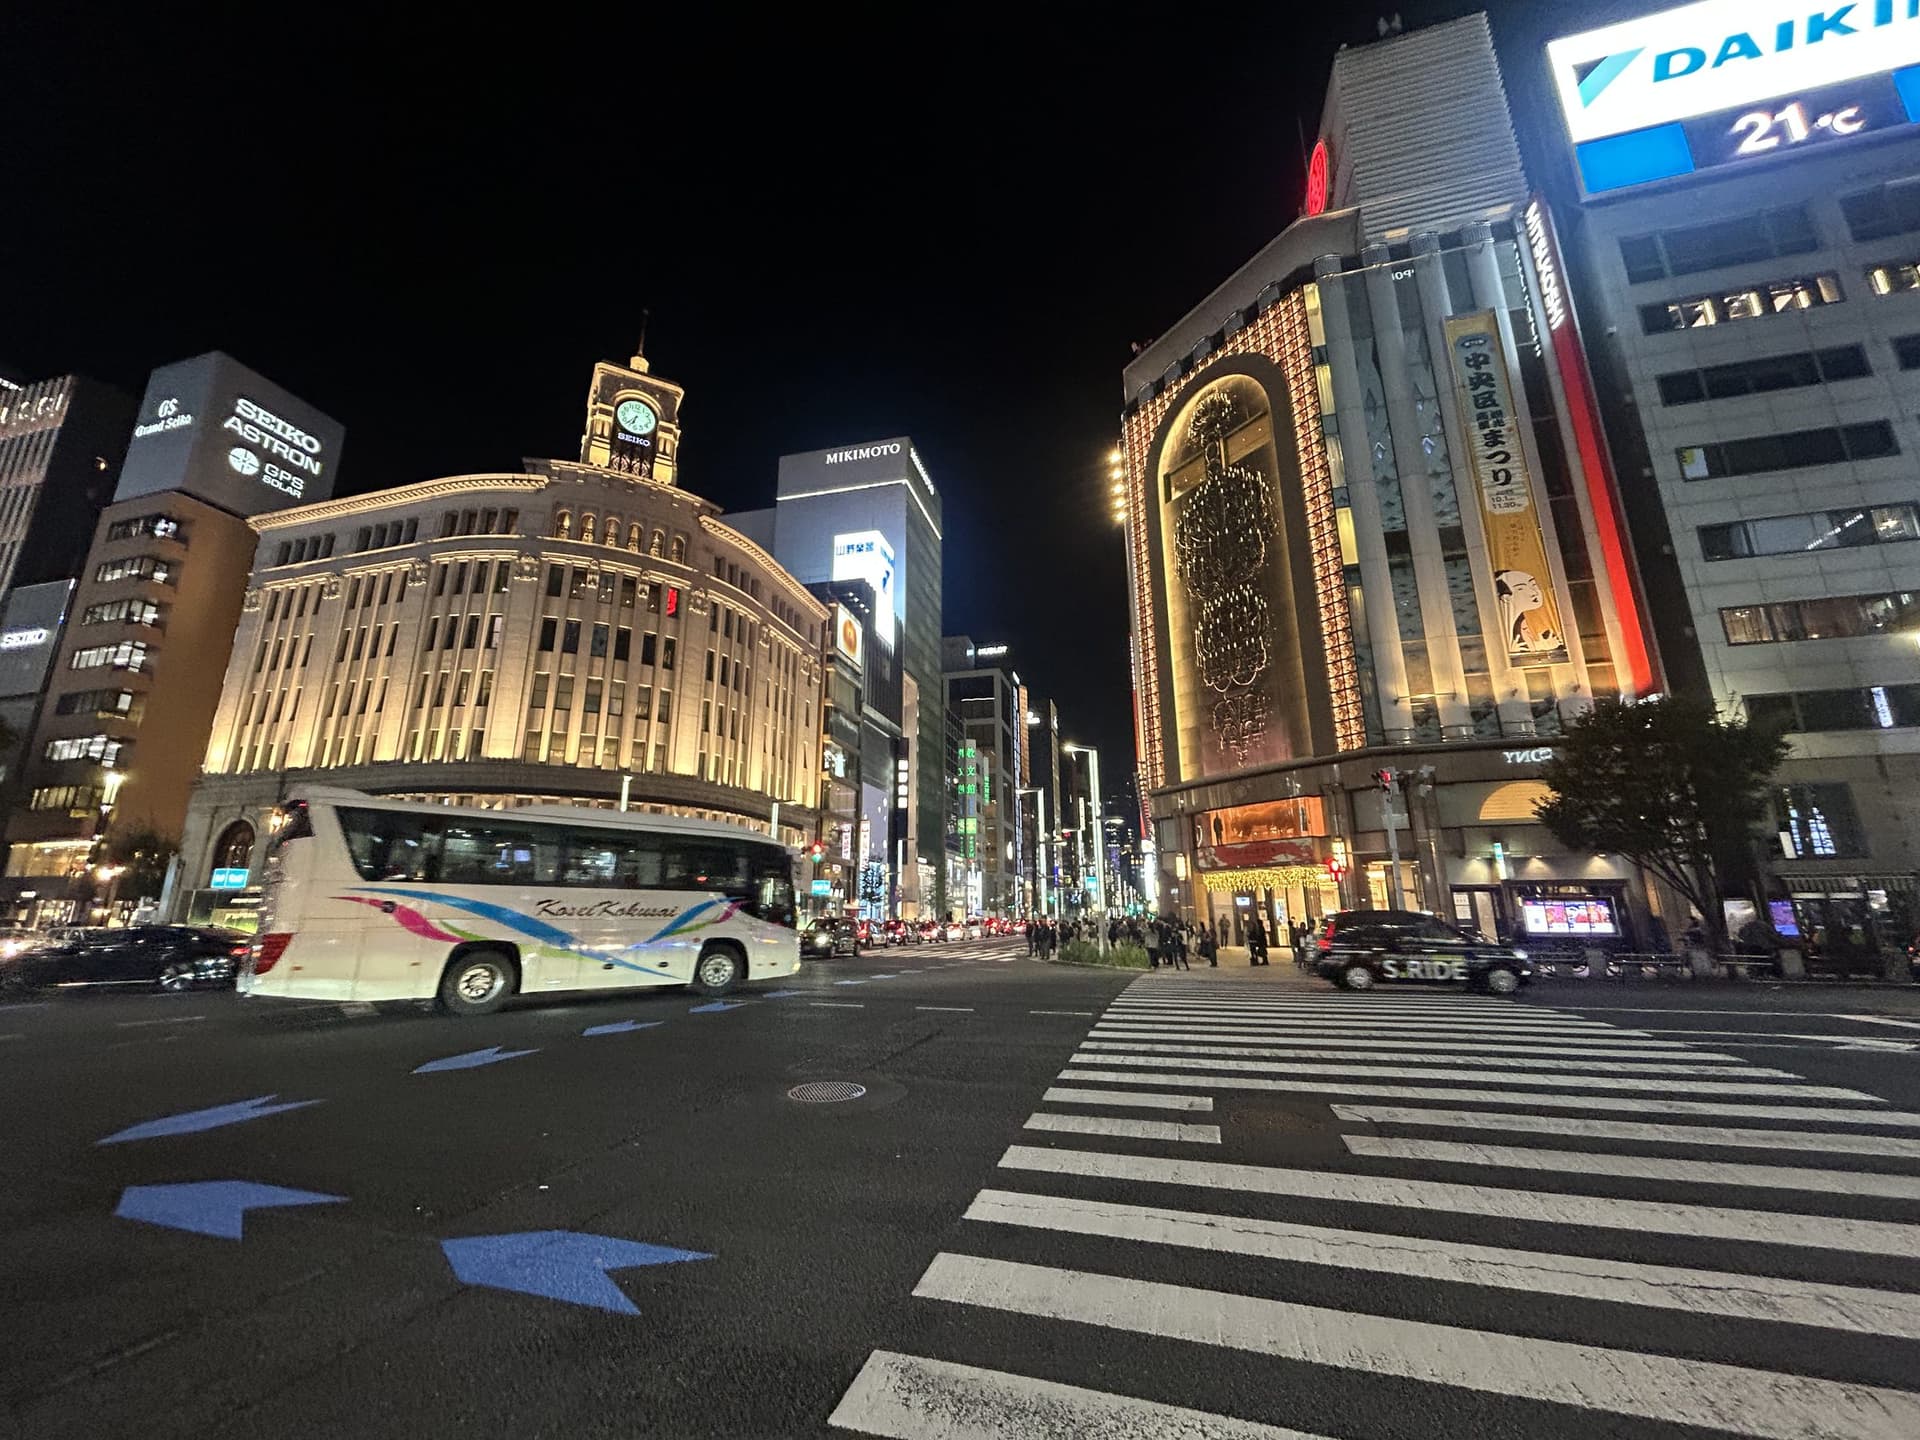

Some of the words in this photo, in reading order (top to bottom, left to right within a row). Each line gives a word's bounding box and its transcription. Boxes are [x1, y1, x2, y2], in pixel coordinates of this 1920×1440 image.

[235, 398, 322, 454] SEIKO
[223, 416, 323, 476] ASTRON
[617, 432, 651, 448] SEIKO
[825, 443, 901, 465] MIKIMOTO
[262, 475, 303, 500] SOLAR
[264, 462, 305, 491] GPS
[595, 900, 679, 917] Kokusai
